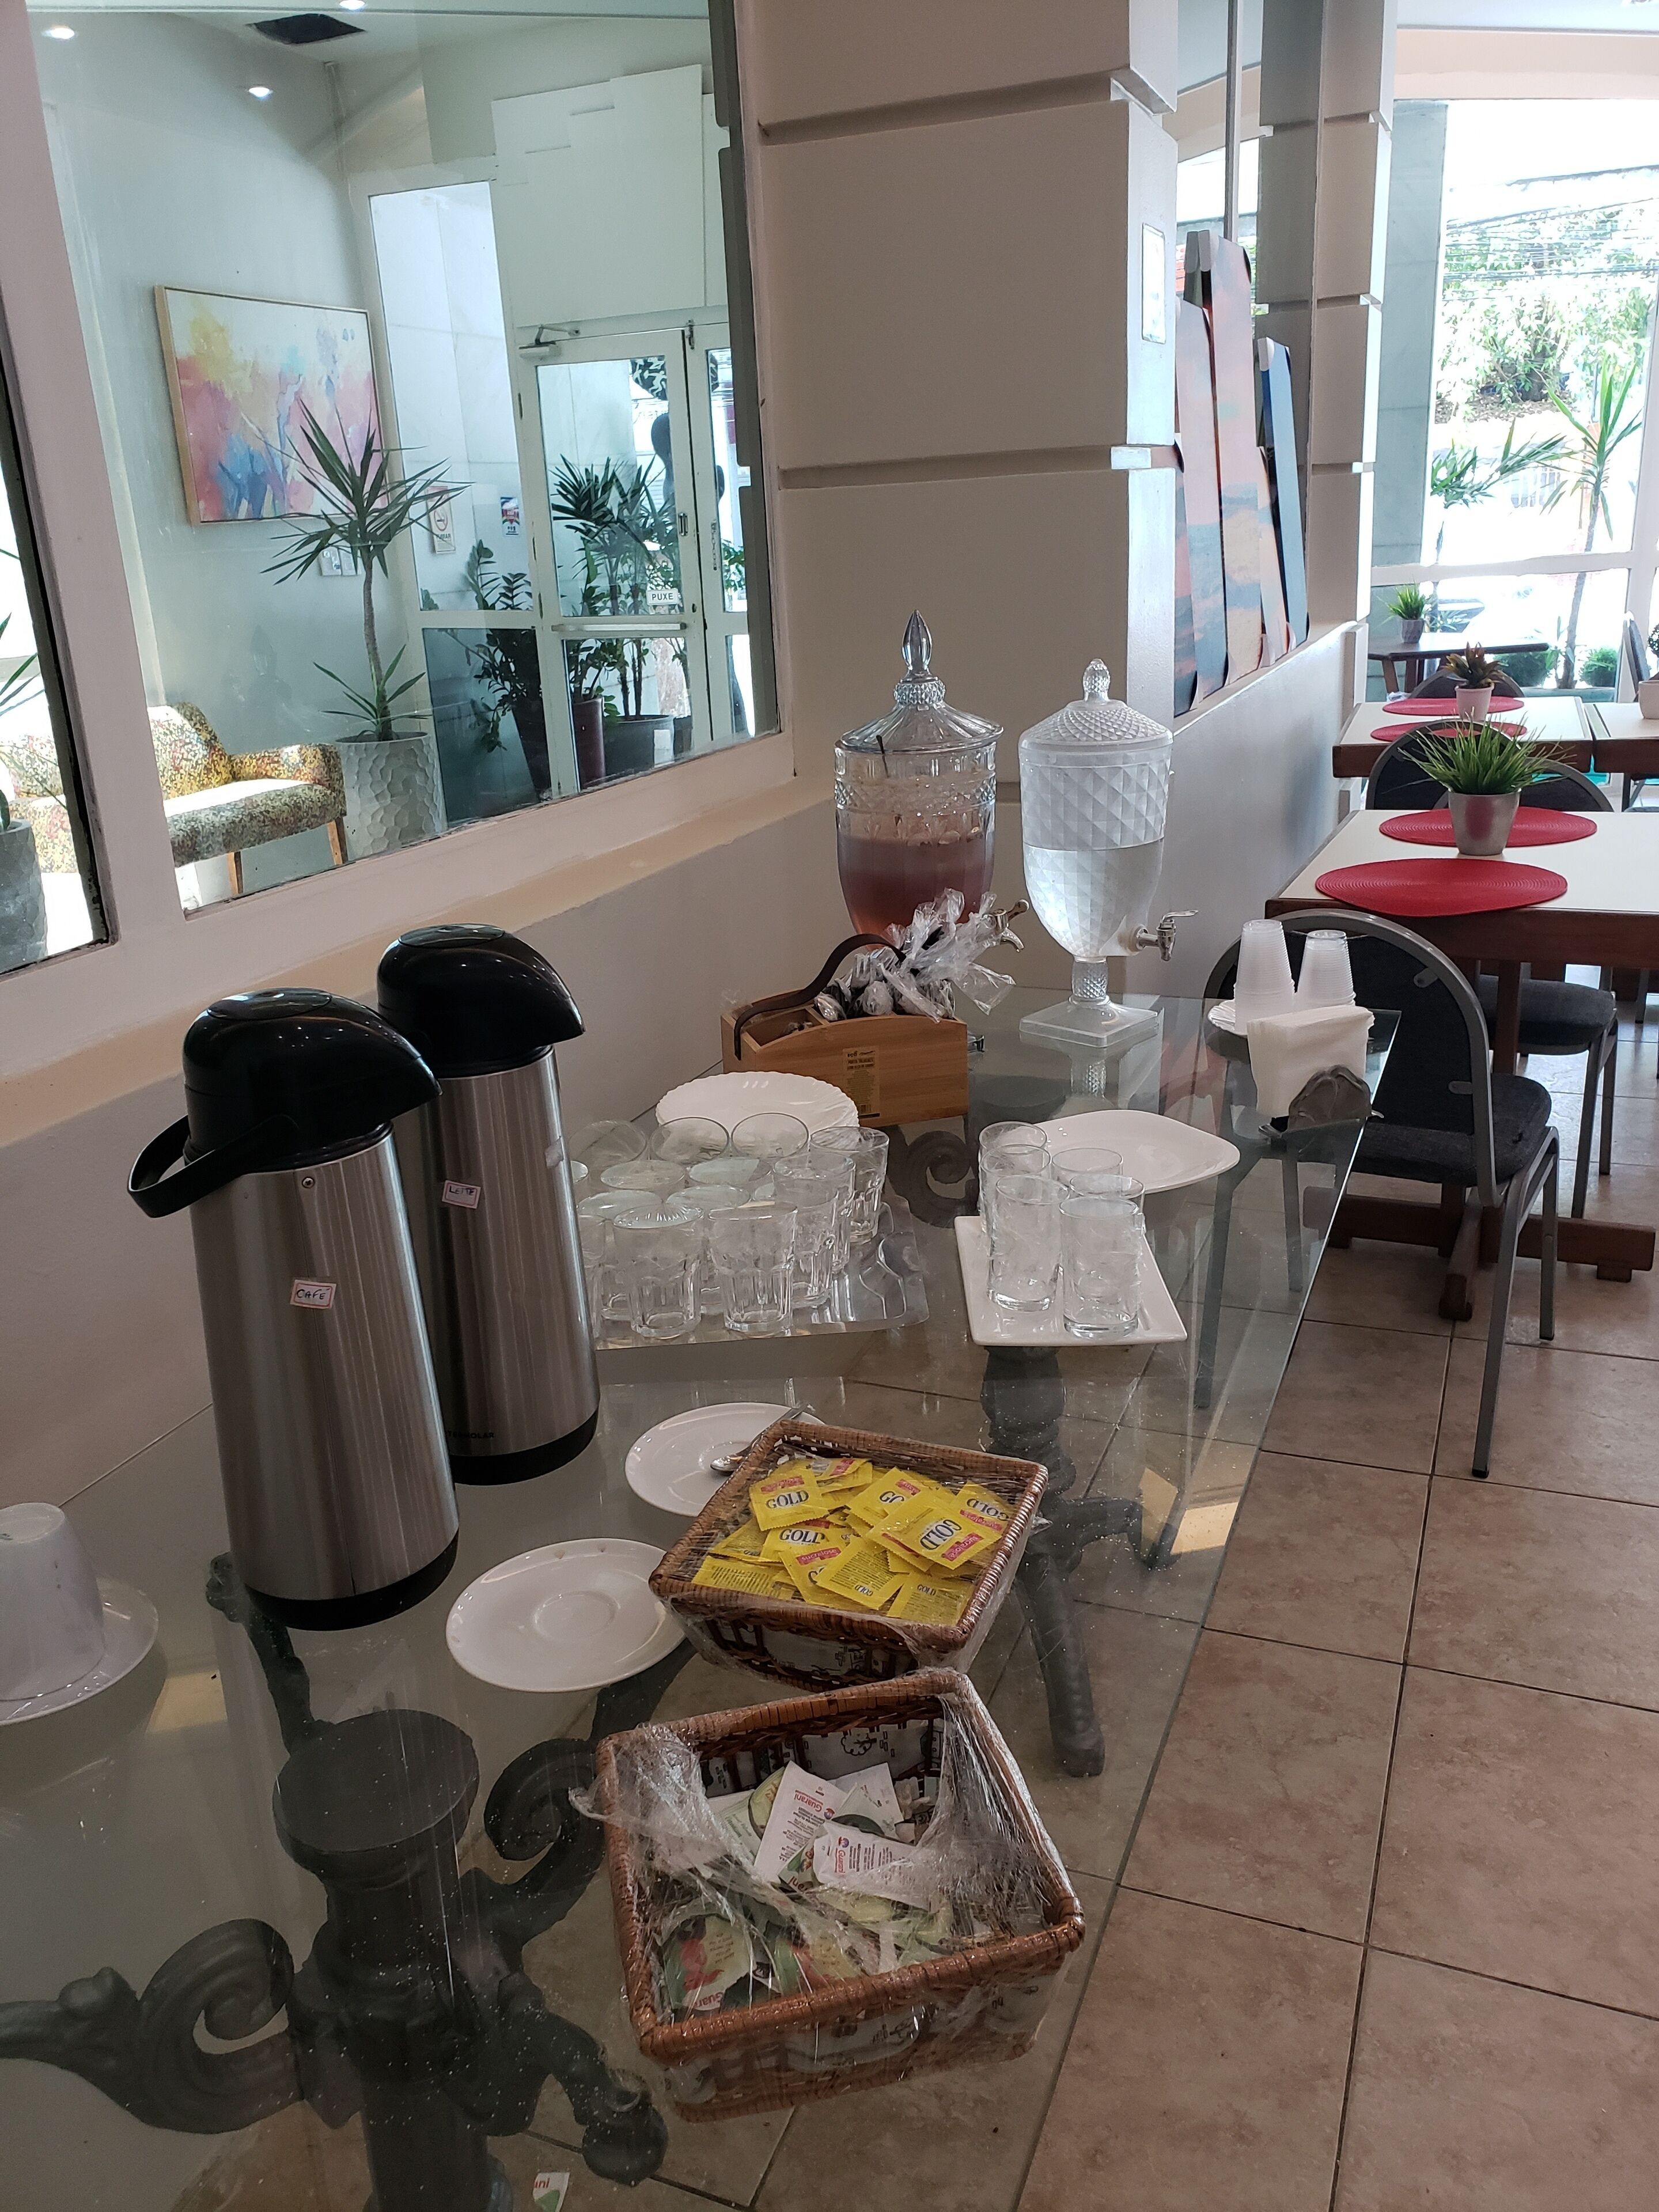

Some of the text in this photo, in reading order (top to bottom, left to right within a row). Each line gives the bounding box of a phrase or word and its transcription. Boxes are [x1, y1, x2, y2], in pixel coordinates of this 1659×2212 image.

[652, 593, 673, 601] PUXE
[449, 1185, 475, 1196] LEITE
[296, 1288, 331, 1300] CAFÉ
[766, 1490, 809, 1509] GOLD
[966, 1498, 1010, 1521] GOLD
[919, 1519, 962, 1551] GOLD
[801, 1547, 838, 1561] sucralose
[949, 1535, 979, 1559] sucralose
[854, 1584, 873, 1596] GOLD
[916, 1584, 936, 1596] GOLD
[794, 1793, 823, 1812] Guarani
